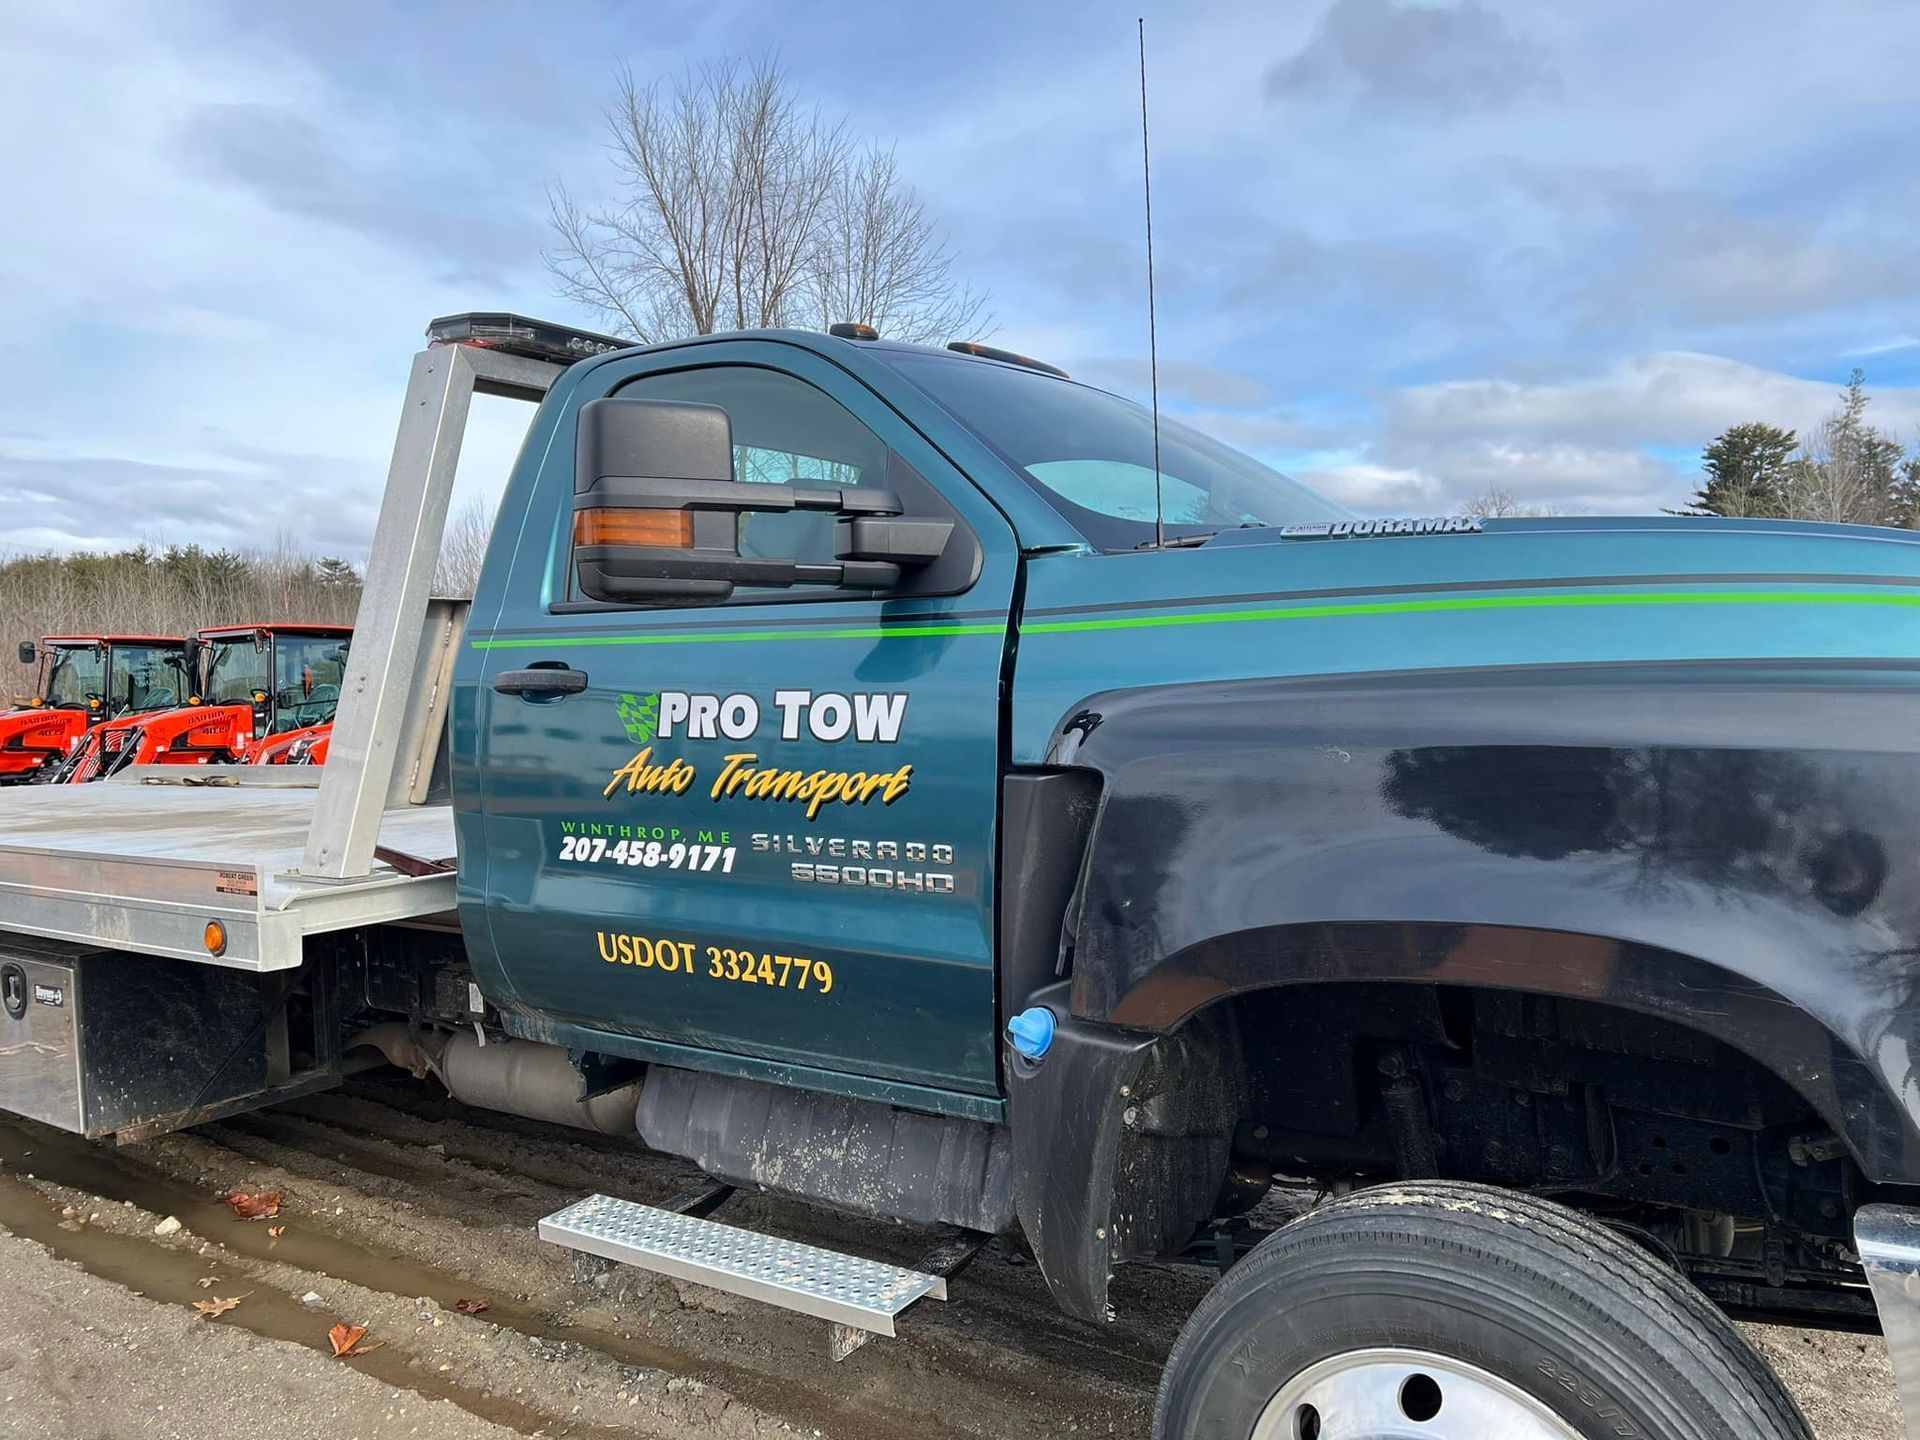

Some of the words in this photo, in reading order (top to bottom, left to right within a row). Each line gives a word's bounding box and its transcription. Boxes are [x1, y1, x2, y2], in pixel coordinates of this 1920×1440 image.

[1333, 517, 1486, 539] DURAMAX
[657, 691, 760, 741] PRO
[774, 690, 909, 743] TOW
[603, 746, 697, 800] Auto
[711, 752, 913, 821] Transport
[561, 821, 687, 843] WINTHROP,
[698, 830, 731, 844] ME
[751, 833, 954, 864] SILVERADO
[559, 836, 736, 873] 207-458-9171
[791, 862, 955, 893] 5500HD
[597, 931, 696, 974] USDOT
[708, 946, 833, 993] 3324779
[1537, 1355, 1646, 1440] 225/7
